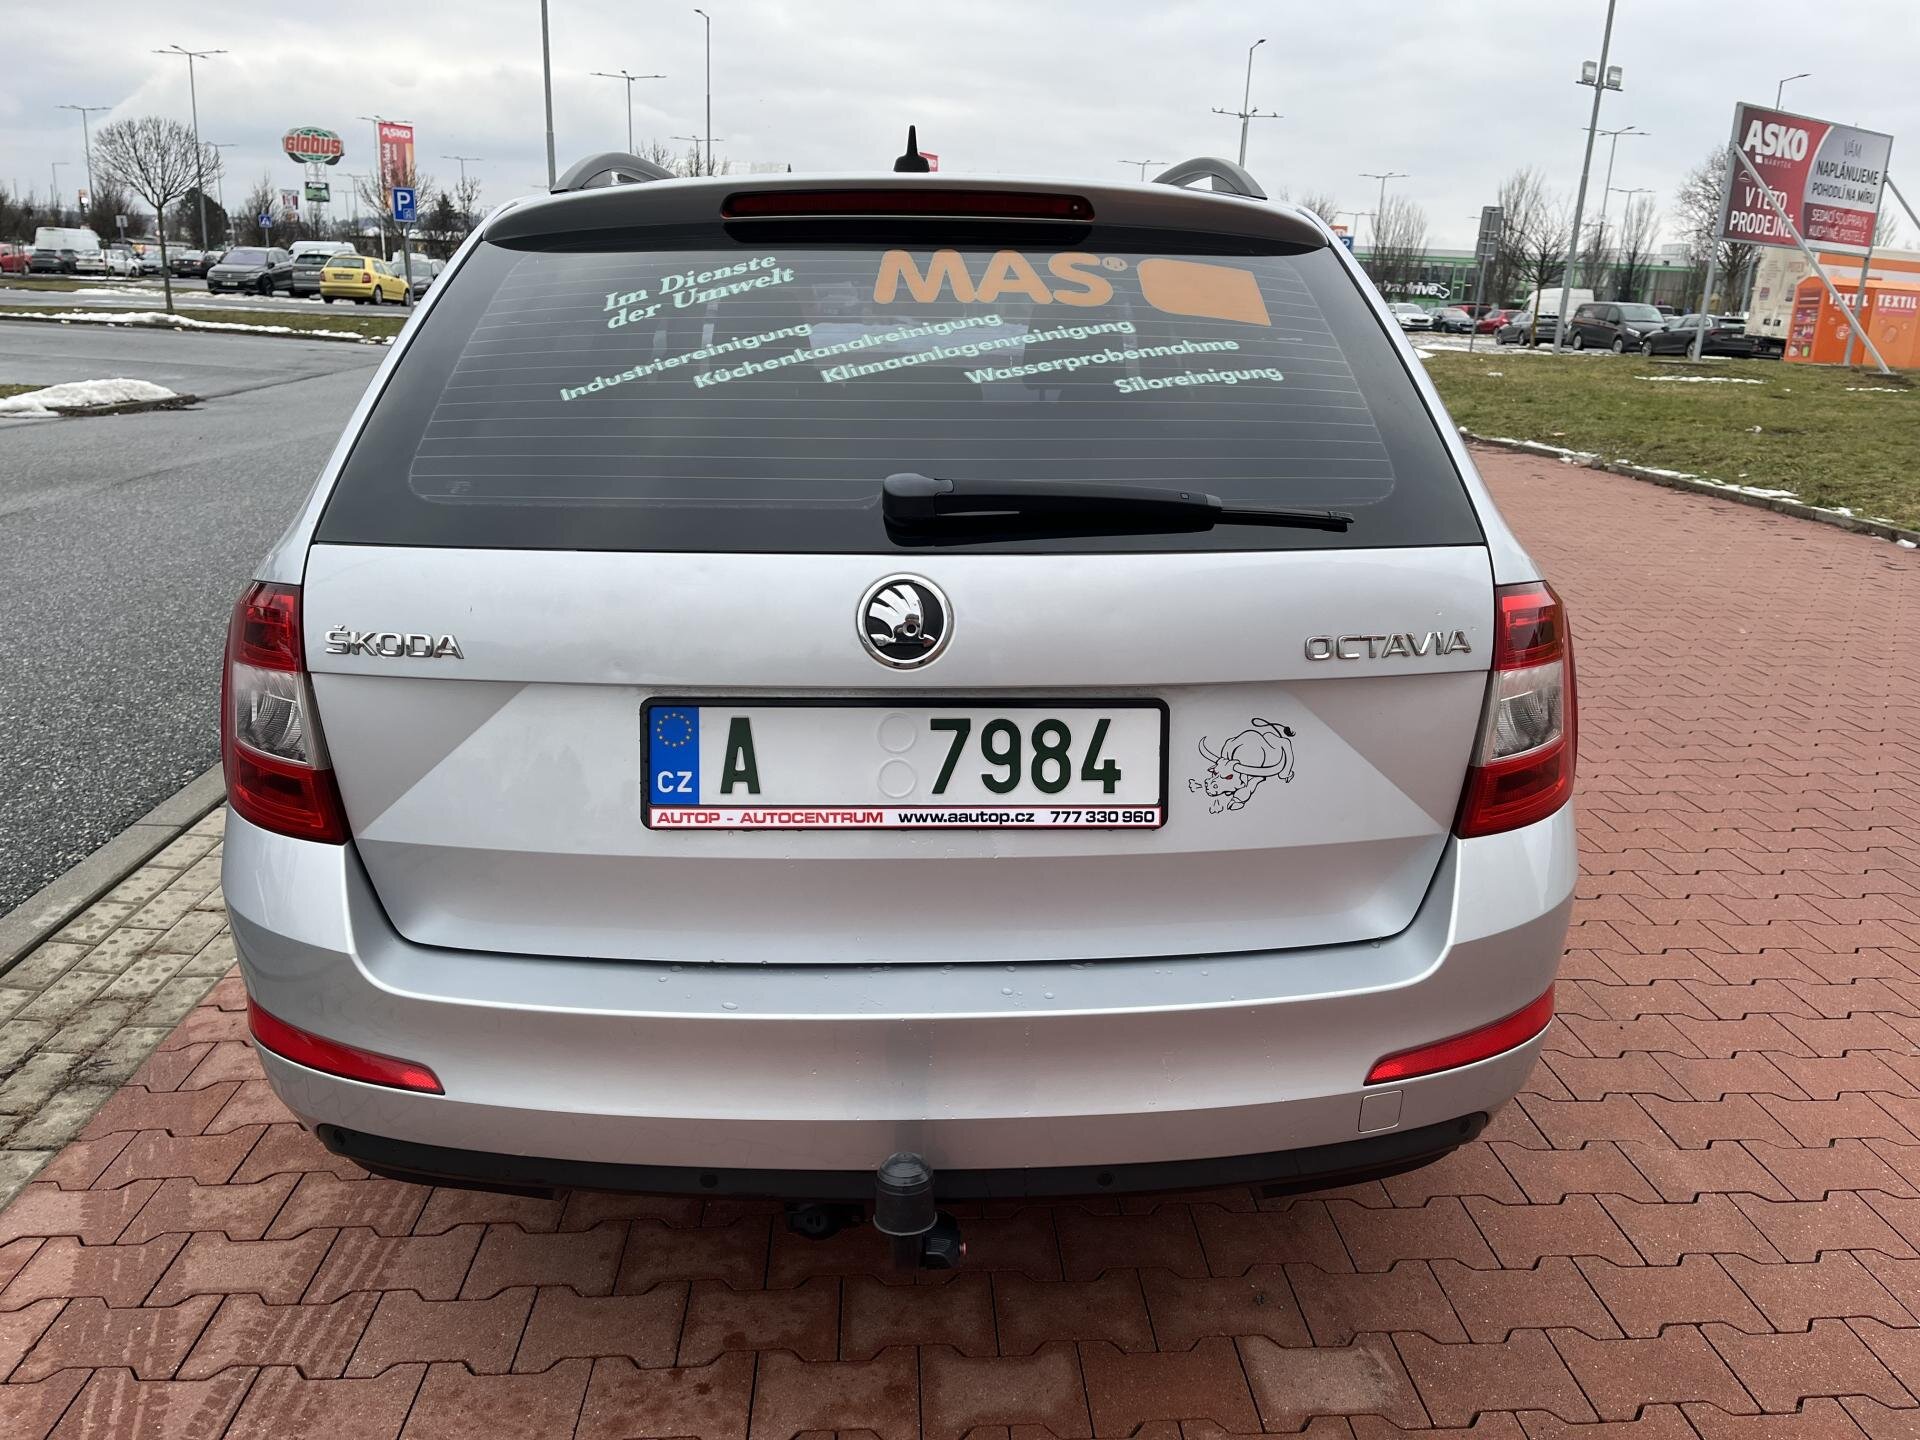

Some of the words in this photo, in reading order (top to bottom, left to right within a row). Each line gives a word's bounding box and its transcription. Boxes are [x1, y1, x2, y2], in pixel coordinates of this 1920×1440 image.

[382, 127, 411, 139] ASKO
[1743, 120, 1809, 163] ASKO
[1816, 160, 1879, 185] NAPLÁNUJEME
[396, 191, 411, 211] P
[1745, 186, 1756, 207] V
[1846, 188, 1856, 201] NA
[603, 288, 649, 312] Im
[658, 255, 777, 296] Dienste
[607, 303, 662, 329] der
[672, 267, 795, 309] Umwelt
[1829, 292, 1869, 307] TXTL
[1878, 294, 1918, 309] TEXTIL
[560, 323, 813, 401] Industriereinigung
[693, 313, 1004, 389] Küchenkanalreinigung
[820, 320, 1137, 384] Klimaanlagenreinigung
[964, 338, 1240, 385] Wasserprobennahme
[1113, 366, 1285, 394] Siloreinigung
[325, 624, 464, 660] ŠKODA
[1305, 629, 1472, 661] OCTAVIA
[930, 718, 1121, 794] 7984
[657, 770, 693, 793] CZ
[657, 812, 721, 824] AUTOP
[740, 812, 884, 824] AUTOCENTRUM
[898, 811, 1035, 825] www.aautop.cz
[1050, 811, 1082, 823] 777
[1085, 811, 1118, 823] 330
[1122, 811, 1155, 823] 960
